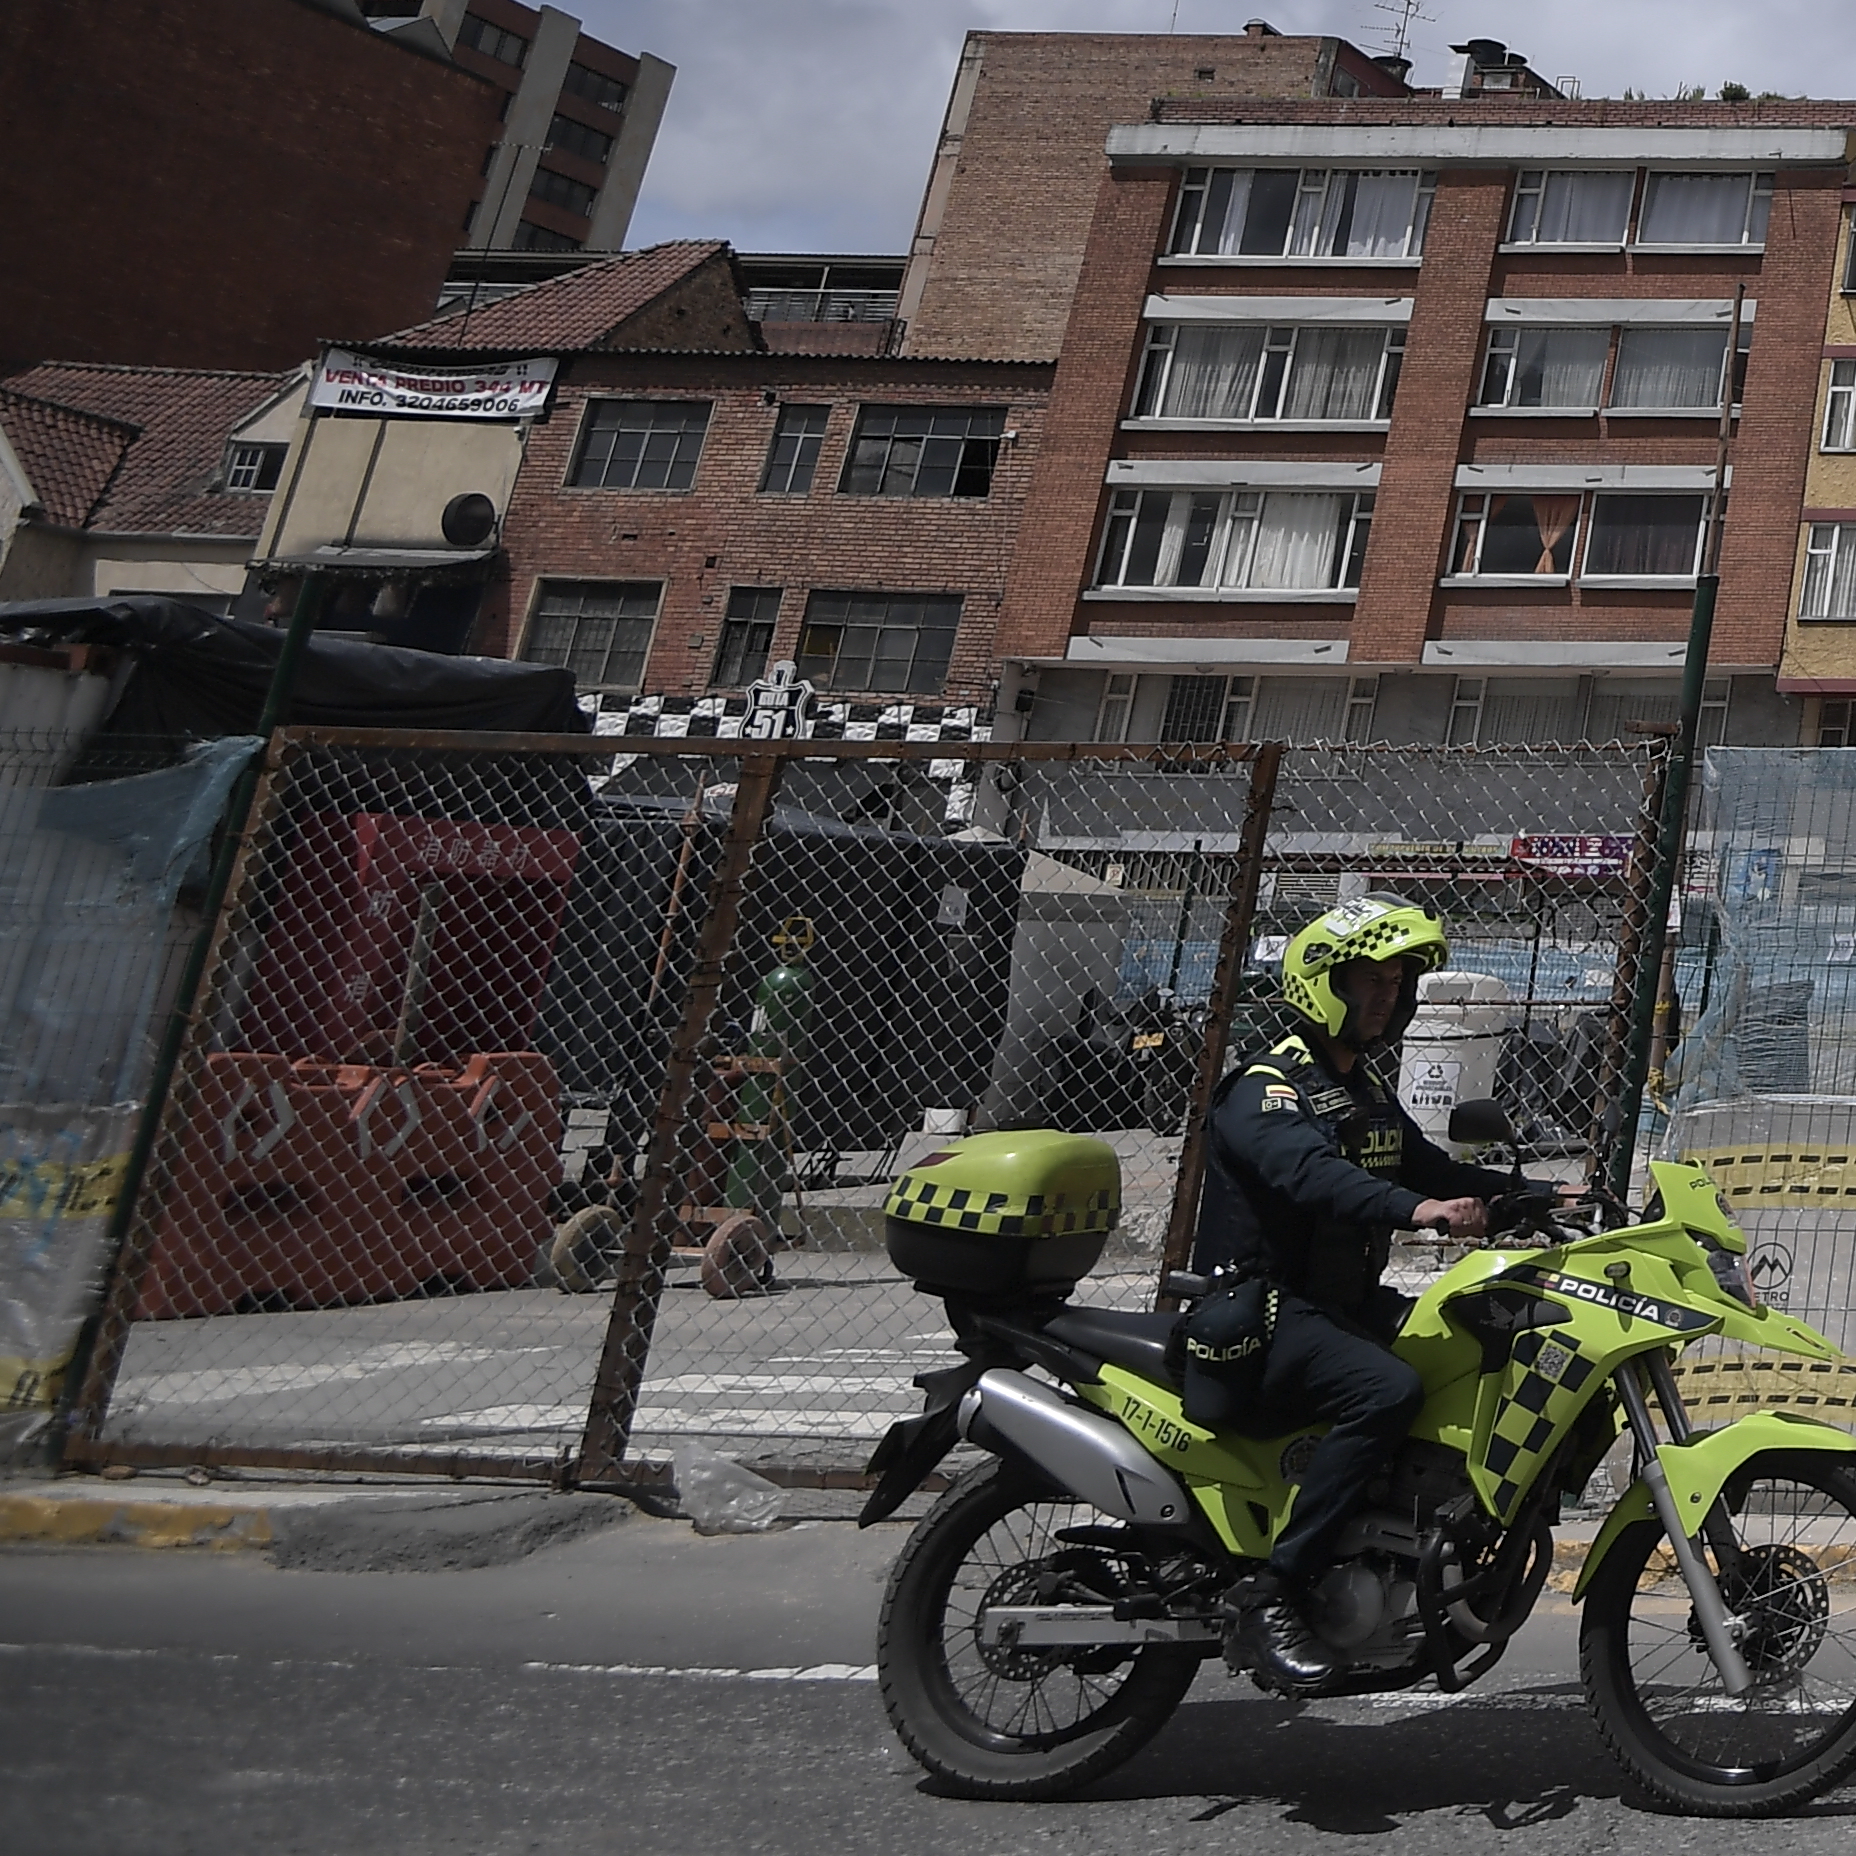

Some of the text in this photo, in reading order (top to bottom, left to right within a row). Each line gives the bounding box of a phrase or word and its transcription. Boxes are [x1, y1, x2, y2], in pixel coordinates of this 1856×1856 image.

[395, 378, 465, 394] PREDIO
[519, 381, 549, 394] MT
[338, 389, 520, 412] INFO. 3204659006
[751, 710, 787, 739] 51
[1559, 1279, 1659, 1321] POLICÍA
[1187, 1336, 1262, 1362] POLICÍA
[1121, 1396, 1192, 1452] 17-1-1516
